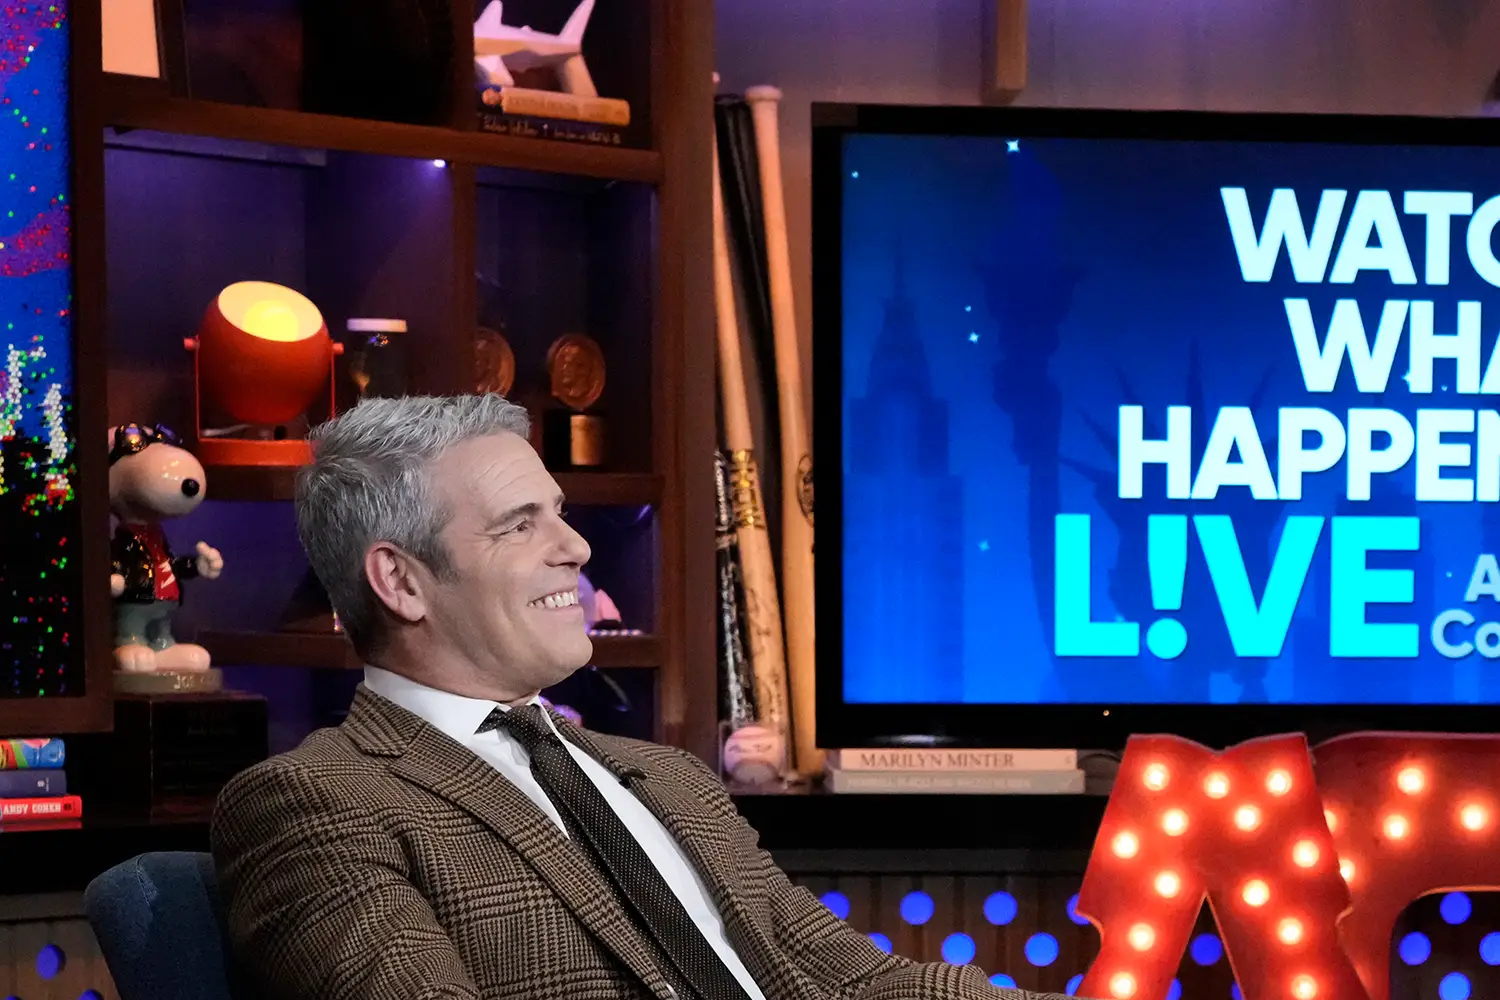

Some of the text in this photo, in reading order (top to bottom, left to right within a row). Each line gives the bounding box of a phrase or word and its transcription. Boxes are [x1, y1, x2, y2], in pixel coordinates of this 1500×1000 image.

[1054, 514, 1420, 660] L!VE
[860, 752, 1015, 768] MARILYN MINTER
[3, 804, 29, 815] ANDY
[32, 803, 62, 814] COHEN
